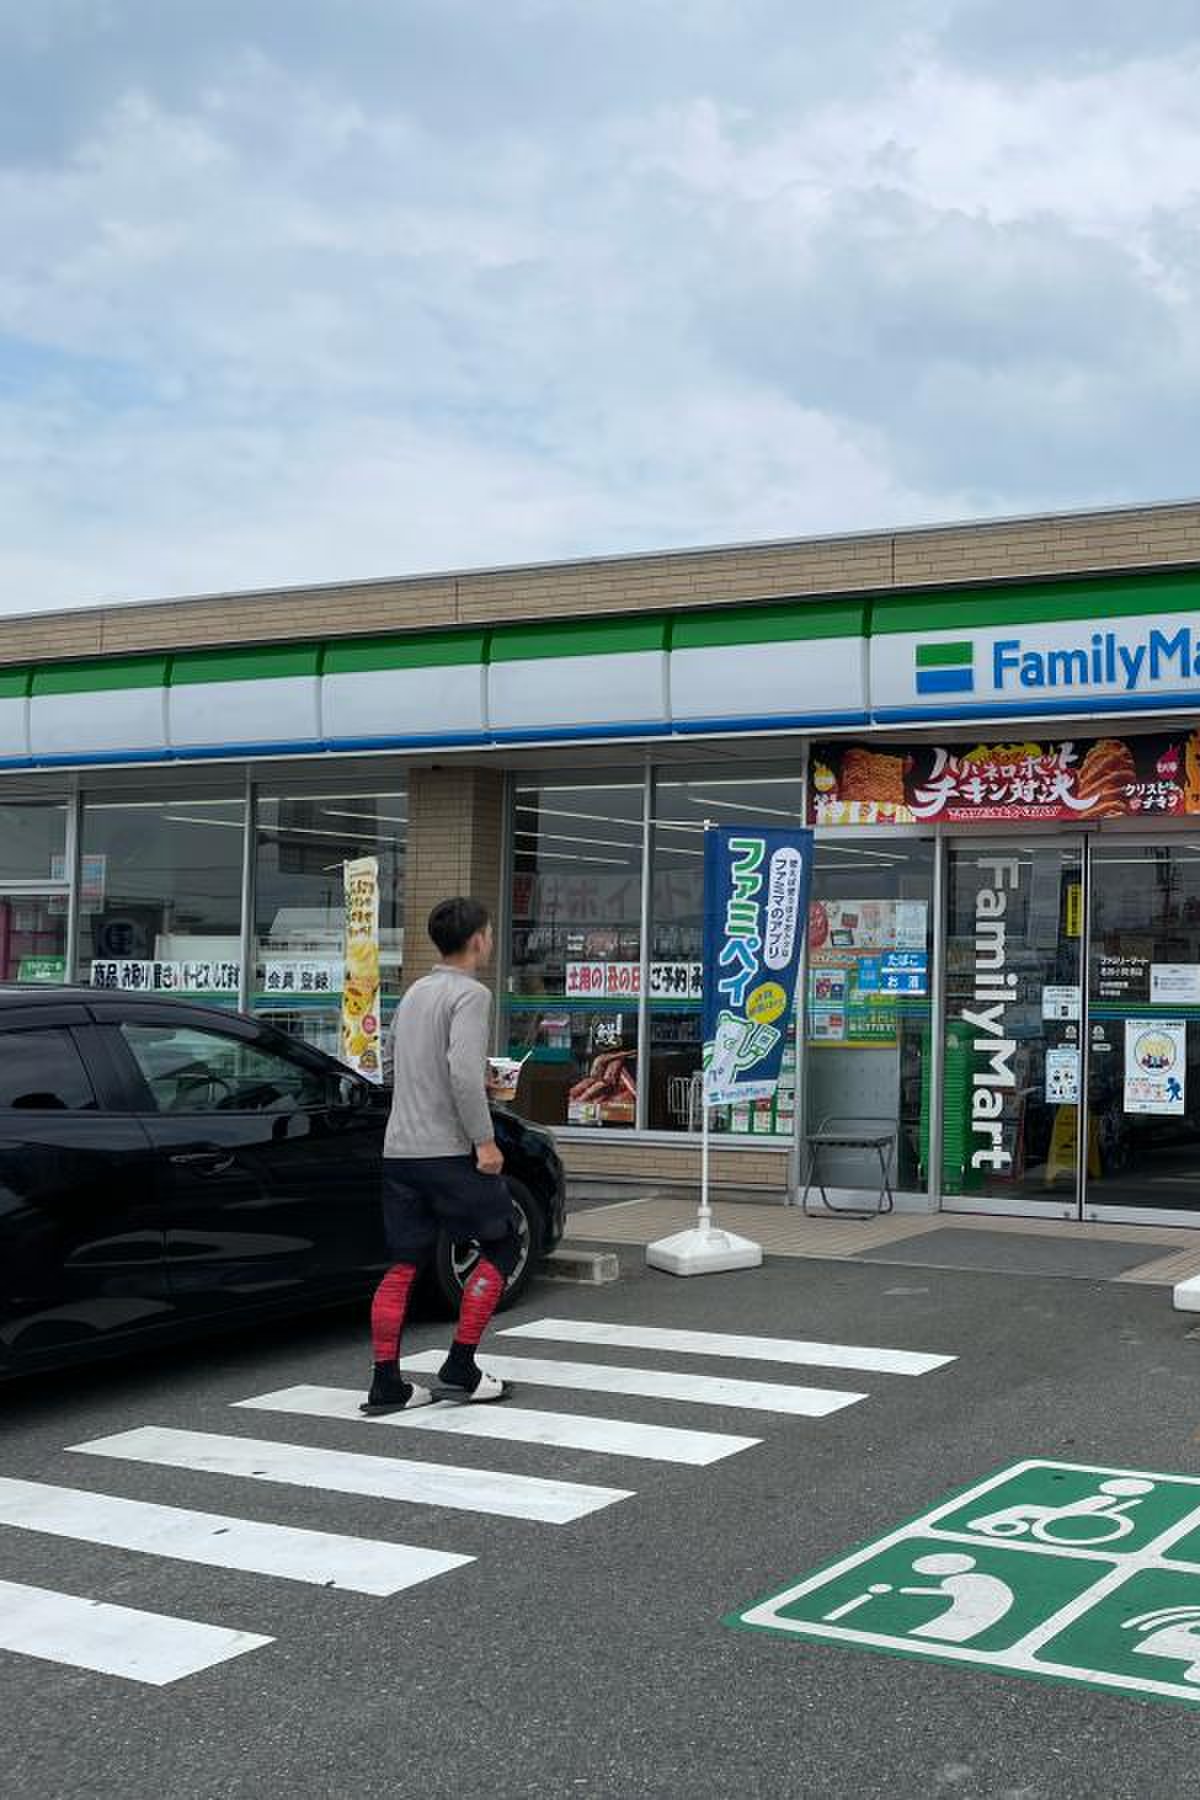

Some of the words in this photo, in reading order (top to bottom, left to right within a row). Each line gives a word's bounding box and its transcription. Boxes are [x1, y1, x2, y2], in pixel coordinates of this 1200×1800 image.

[908, 772, 1100, 816] チキン対決
[719, 837, 766, 1006] ファミペイ
[769, 858, 787, 959] ファミマのアプリ
[268, 971, 328, 989] 会員登録
[888, 954, 919, 966] たばこ
[962, 858, 1019, 1169] FamilyMart
